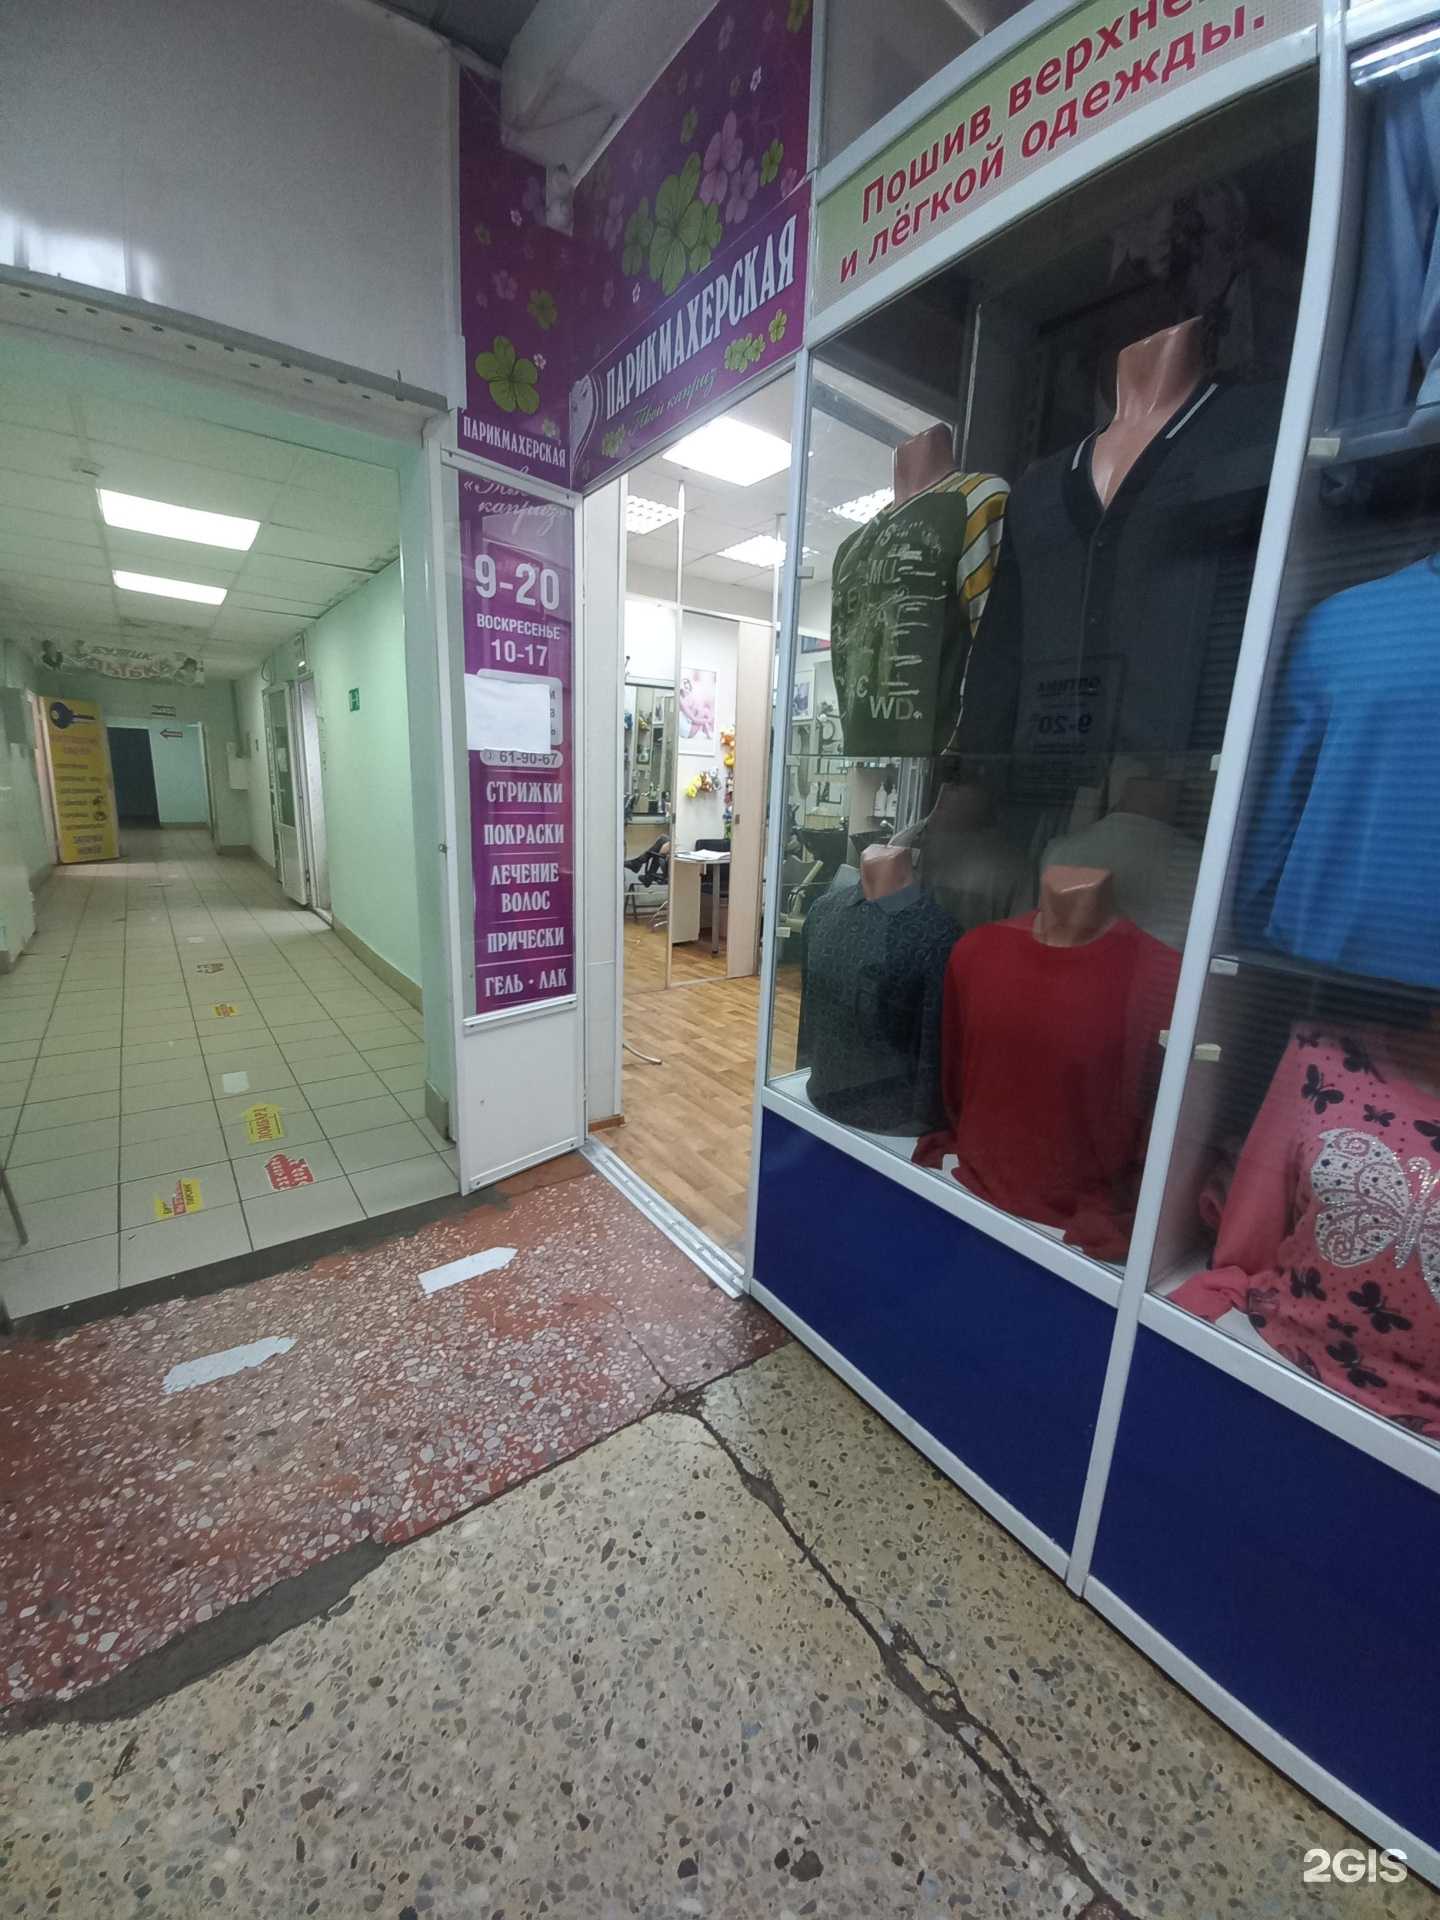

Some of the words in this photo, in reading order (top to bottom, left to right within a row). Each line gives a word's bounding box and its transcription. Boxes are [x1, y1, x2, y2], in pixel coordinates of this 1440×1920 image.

[861, 105, 992, 225] Пошив
[1008, 0, 1200, 118] верхне
[839, 249, 857, 283] и
[867, 135, 1004, 264] лёгкой
[1021, 5, 1265, 158] одежды.
[605, 214, 798, 422] ПАРИКМАХЕРСКАЯ
[463, 416, 566, 469] ПАРИКМАХЕРСКАЯ
[474, 554, 560, 611] 9-20
[476, 612, 561, 641] ВОСКРЕСЕНЬЕ
[491, 639, 549, 667] 10-17
[499, 751, 558, 766] 61-90-67
[486, 781, 563, 804] СТРИЖКИ
[483, 824, 565, 846] ПОКРАСКИ
[490, 862, 560, 886] ЛЕЧЕНИЕ
[501, 890, 551, 913] ВОЛОС
[487, 927, 565, 953] ПРИЧЕСКИ
[484, 973, 524, 997] ГЕЛЬ
[538, 967, 568, 990] ЛАК
